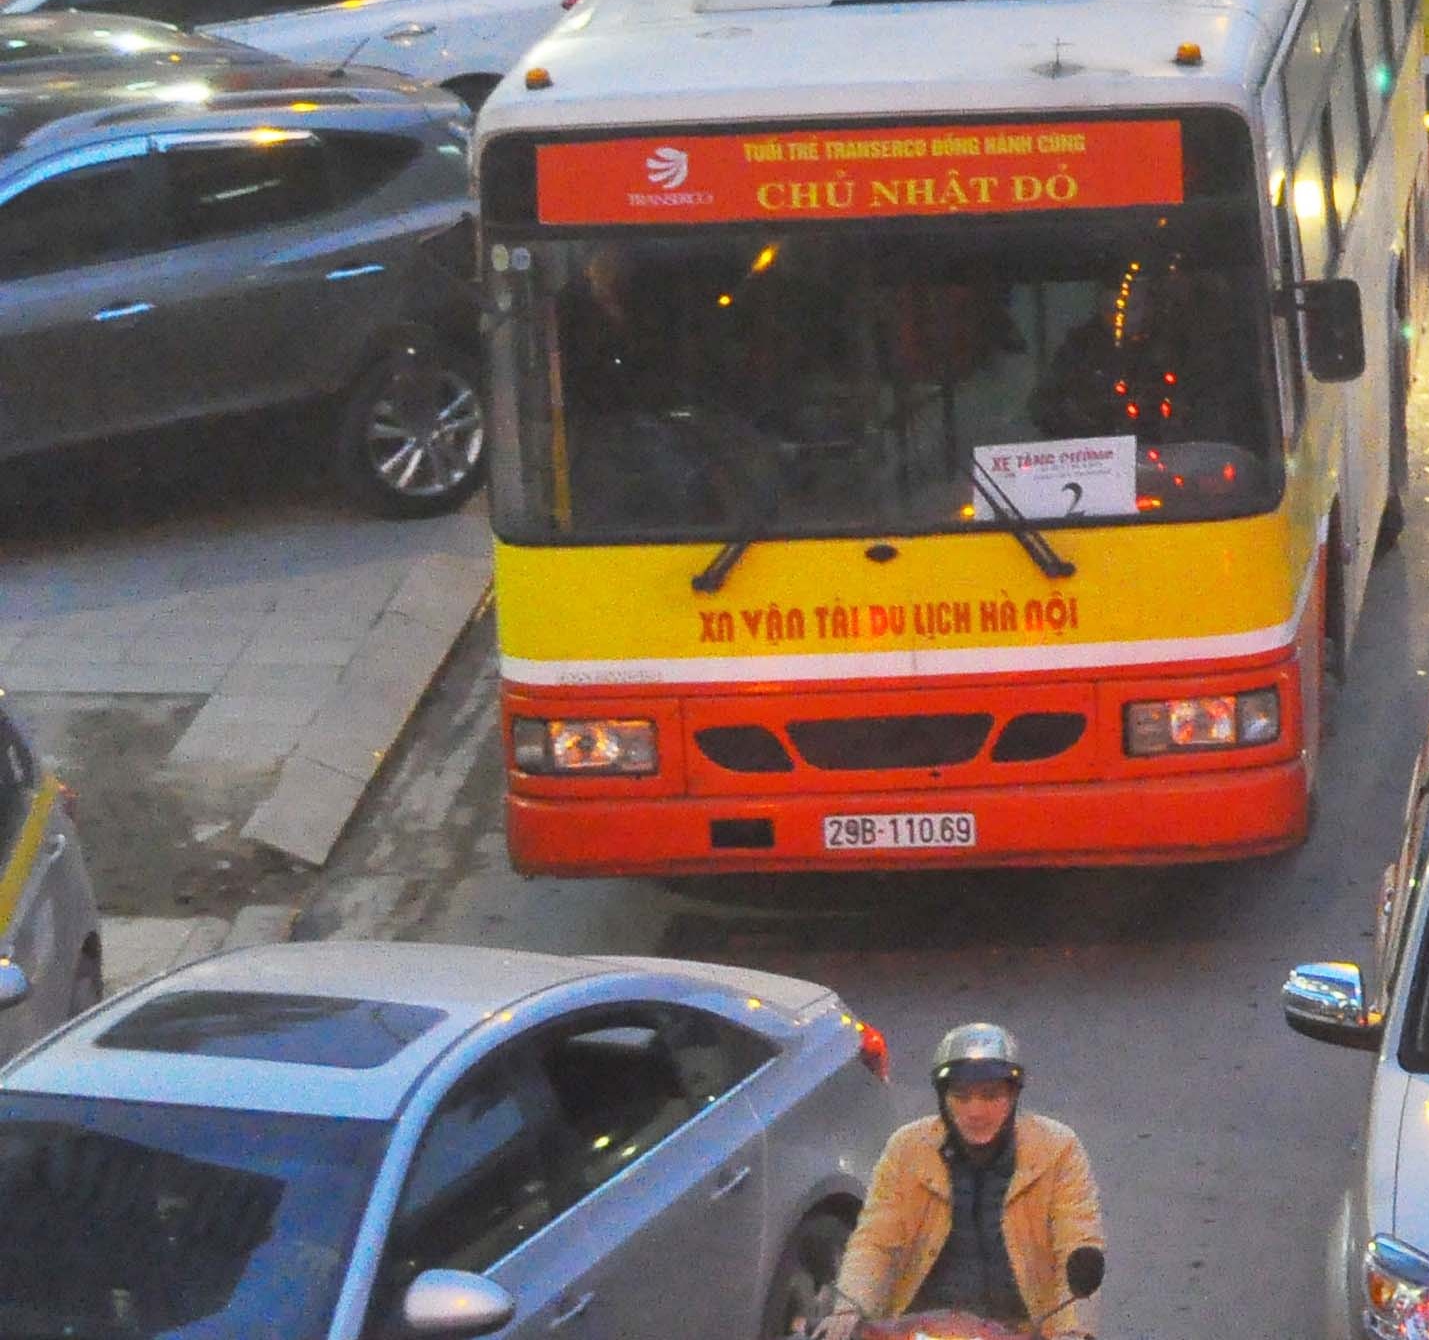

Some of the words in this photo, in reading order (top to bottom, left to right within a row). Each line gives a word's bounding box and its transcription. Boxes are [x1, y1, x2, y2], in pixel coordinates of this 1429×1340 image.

[757, 169, 855, 210] CHỦ
[869, 167, 998, 212] NHẬT
[1010, 162, 1079, 203] ĐỎ
[869, 604, 906, 638] DU
[913, 601, 972, 640] LỊCH
[980, 589, 1018, 633] HÀ
[829, 816, 971, 846] 29B-110.69
